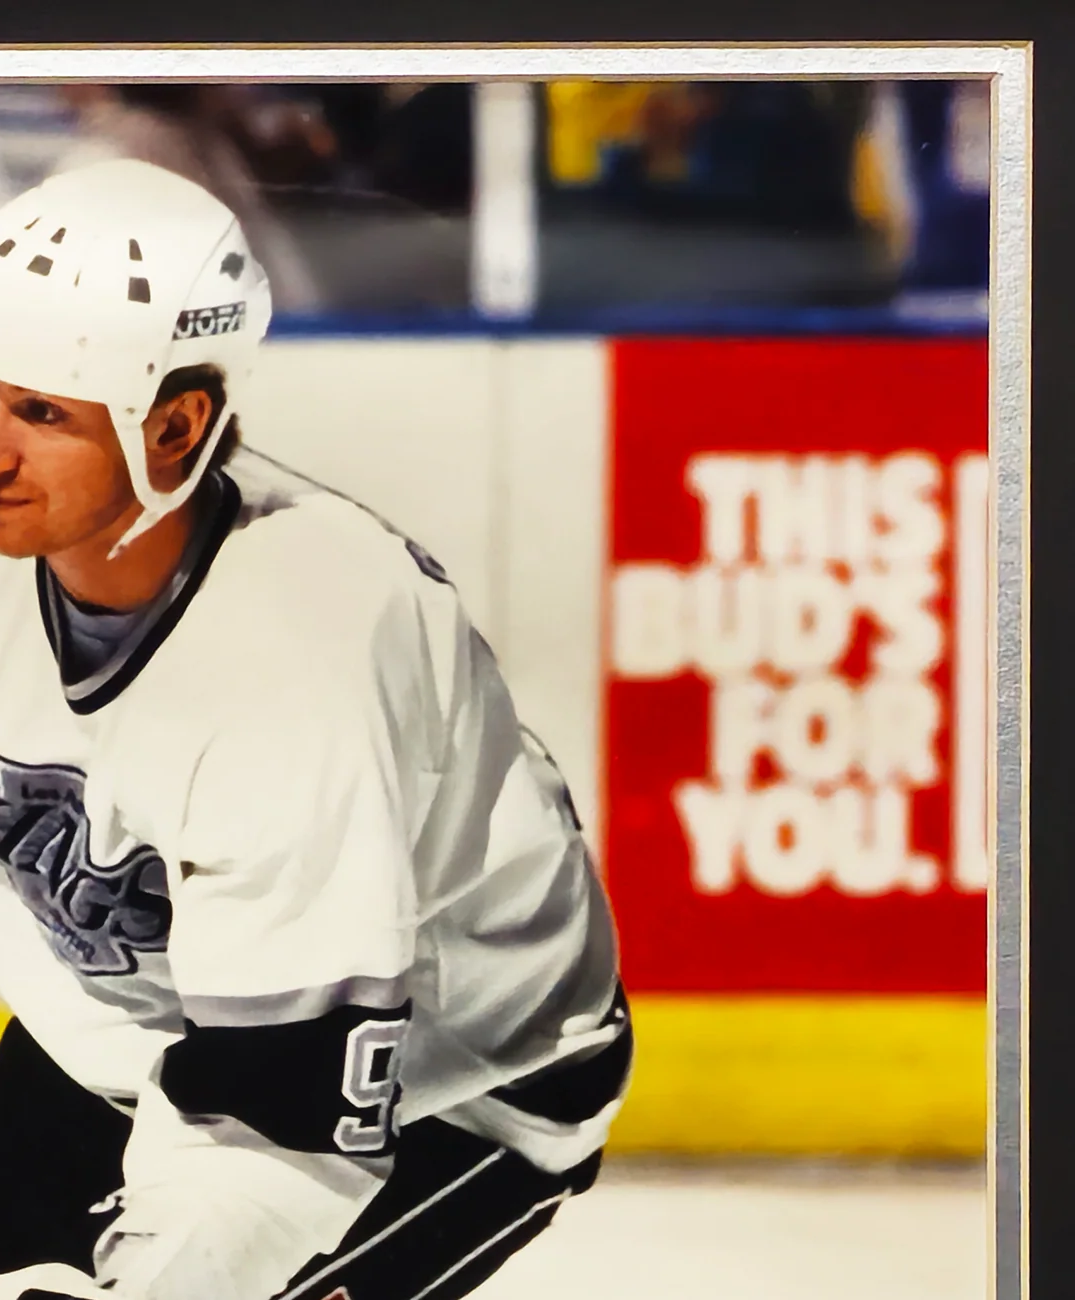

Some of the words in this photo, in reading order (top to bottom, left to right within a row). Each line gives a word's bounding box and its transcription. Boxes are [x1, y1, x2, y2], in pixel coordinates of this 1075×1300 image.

[686, 450, 944, 564] THIS
[614, 563, 944, 678] BUD'S
[711, 682, 940, 785] FOR
[673, 781, 940, 893] YOU.
